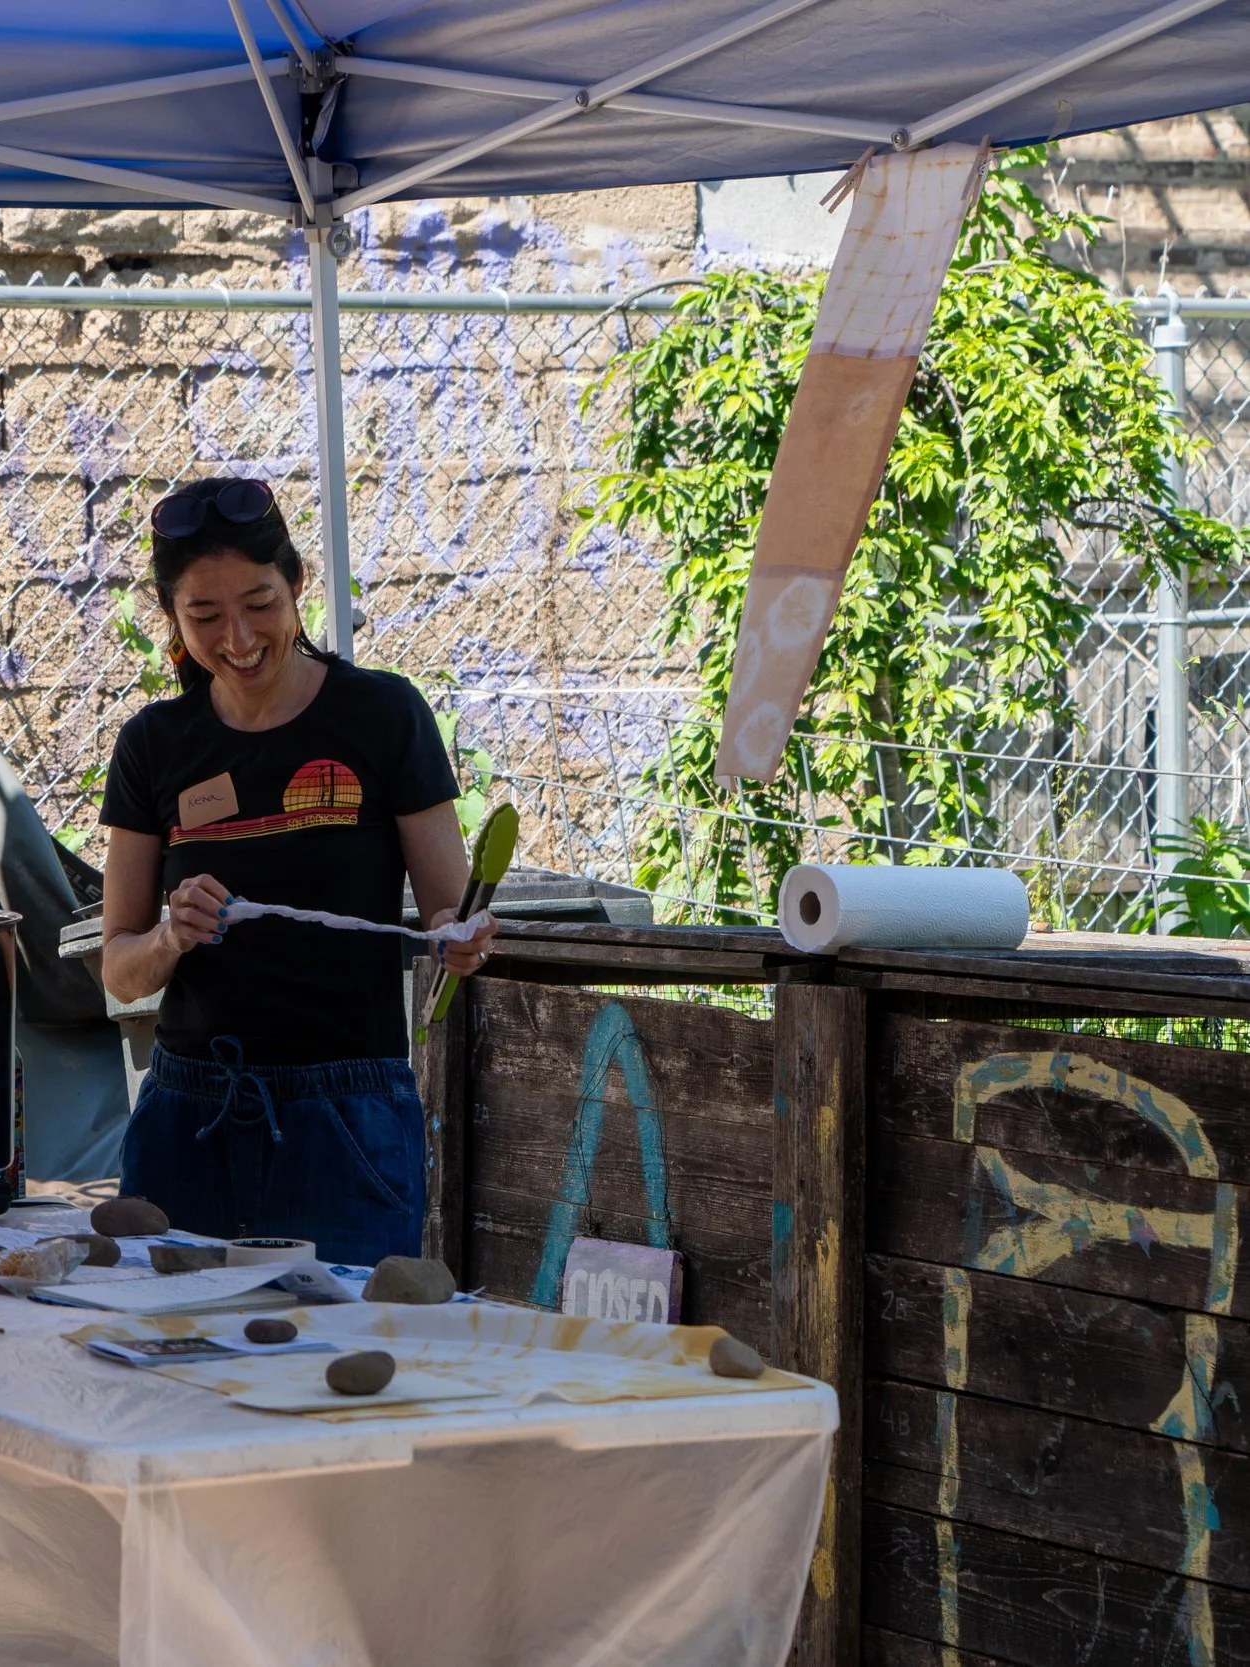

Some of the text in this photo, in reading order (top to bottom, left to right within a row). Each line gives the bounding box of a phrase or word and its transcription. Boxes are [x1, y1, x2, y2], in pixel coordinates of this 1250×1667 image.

[287, 813, 358, 831] SAN FRANCISCO
[562, 1269, 668, 1324] CLOSED
[879, 1404, 911, 1436] 4B
